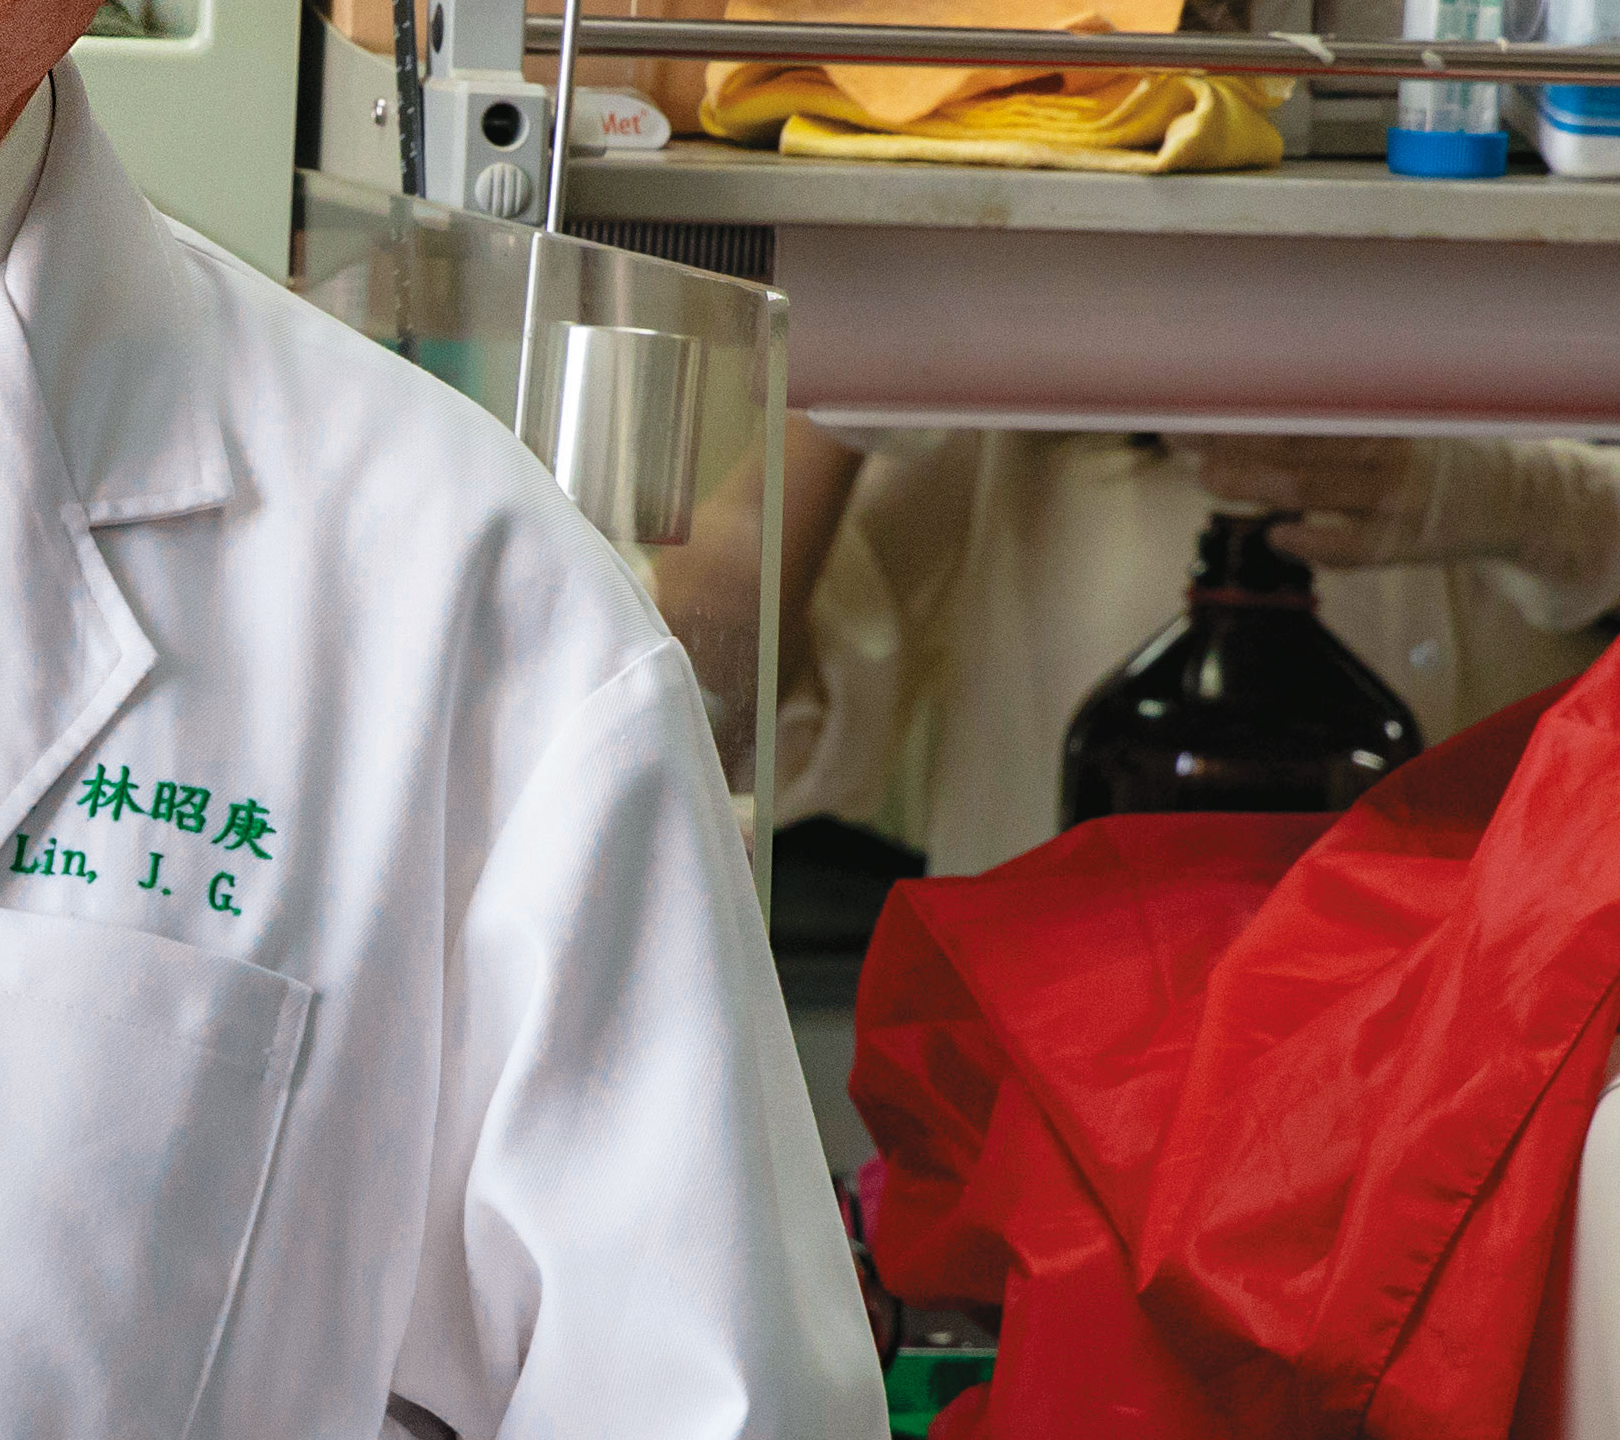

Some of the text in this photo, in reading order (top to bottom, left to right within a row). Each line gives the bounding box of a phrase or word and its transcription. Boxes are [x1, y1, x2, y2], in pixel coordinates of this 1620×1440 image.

[77, 763, 277, 860] 林昭庚
[9, 832, 242, 917] Lin, J. G.
